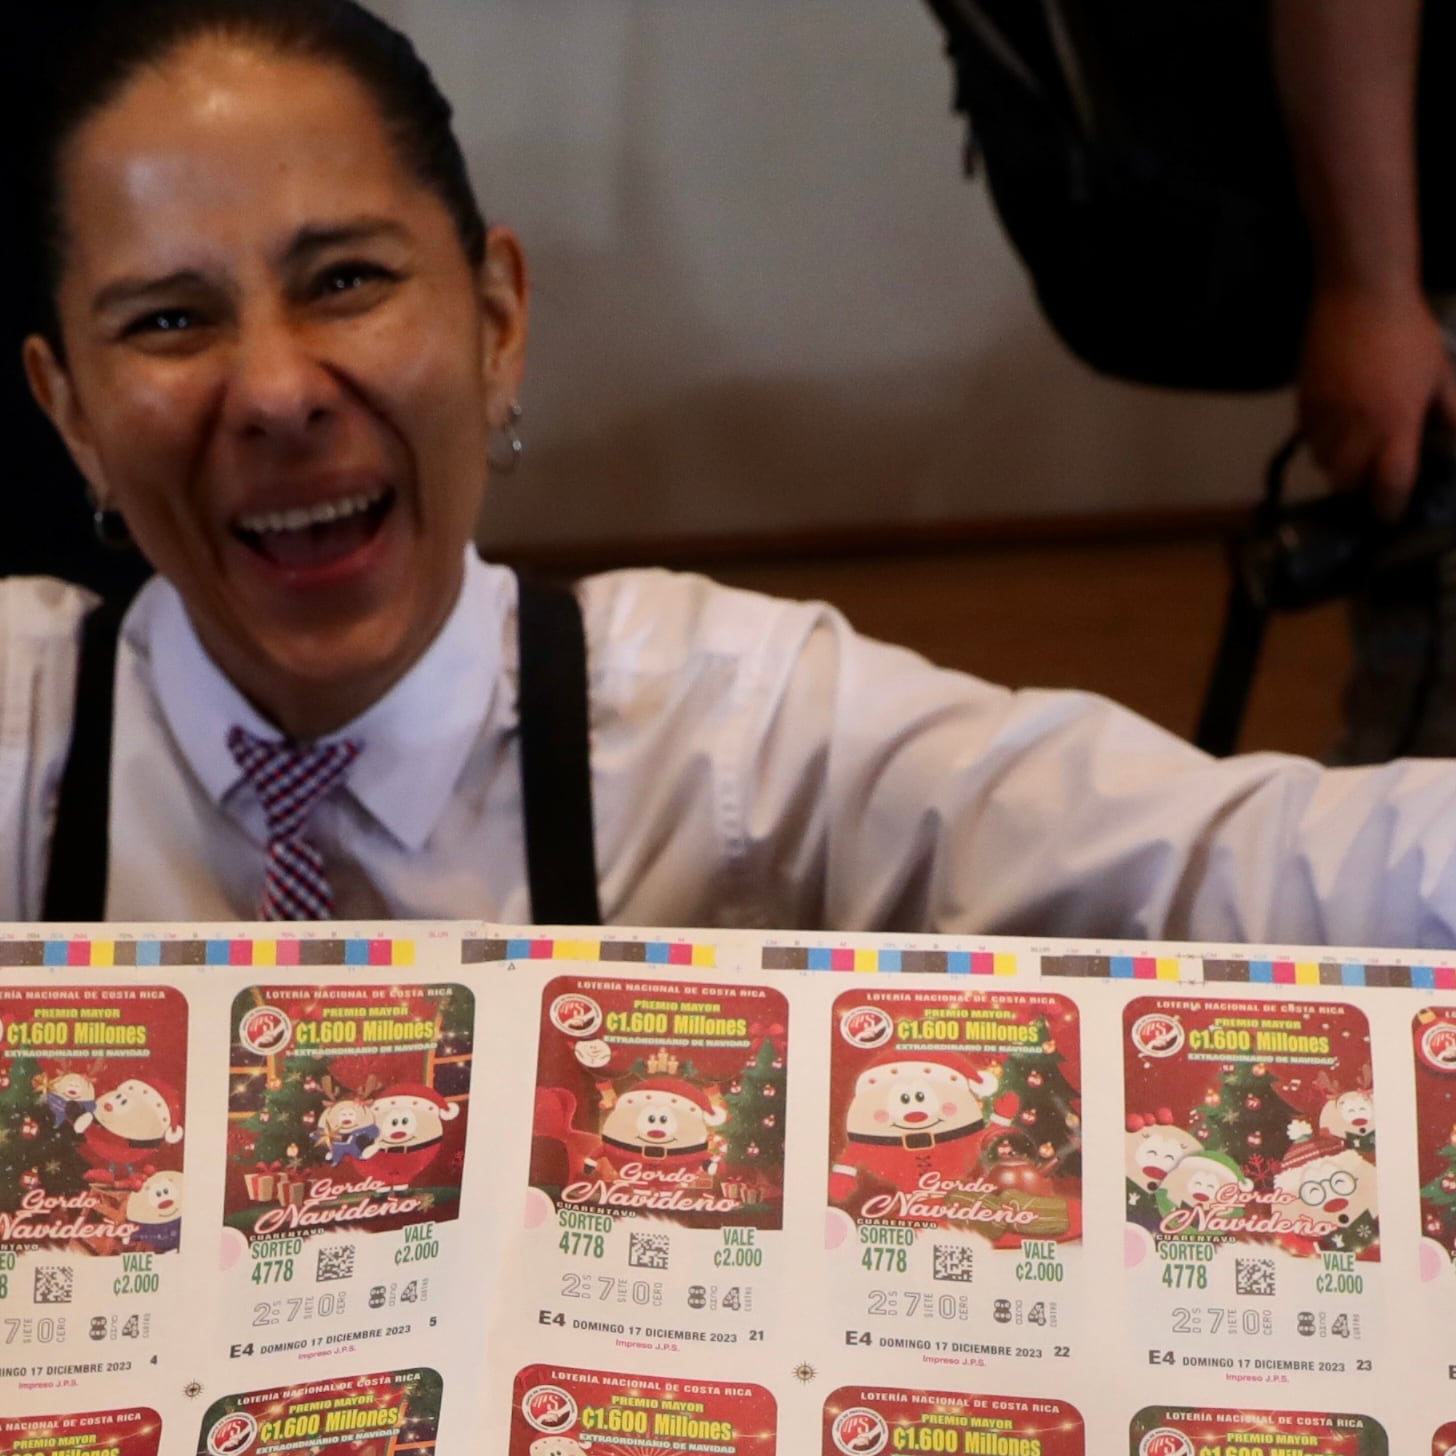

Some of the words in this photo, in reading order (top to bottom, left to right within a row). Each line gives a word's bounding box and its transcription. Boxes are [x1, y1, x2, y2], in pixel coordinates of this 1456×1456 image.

[626, 984, 680, 992] NACIONAL
[34, 1009, 78, 1018] PREMIO
[81, 1009, 119, 1017] MAYOR
[965, 1022, 1039, 1041] Millones
[304, 1176, 384, 1204] Gordo
[255, 1196, 422, 1234] Navideño
[1160, 1242, 1213, 1261] SORTEO
[1162, 1264, 1207, 1289] 4778
[6, 1420, 59, 1431] NACIONAL
[63, 1419, 76, 1427] DE
[80, 1416, 113, 1425] COSTA
[117, 1413, 141, 1422] RICA
